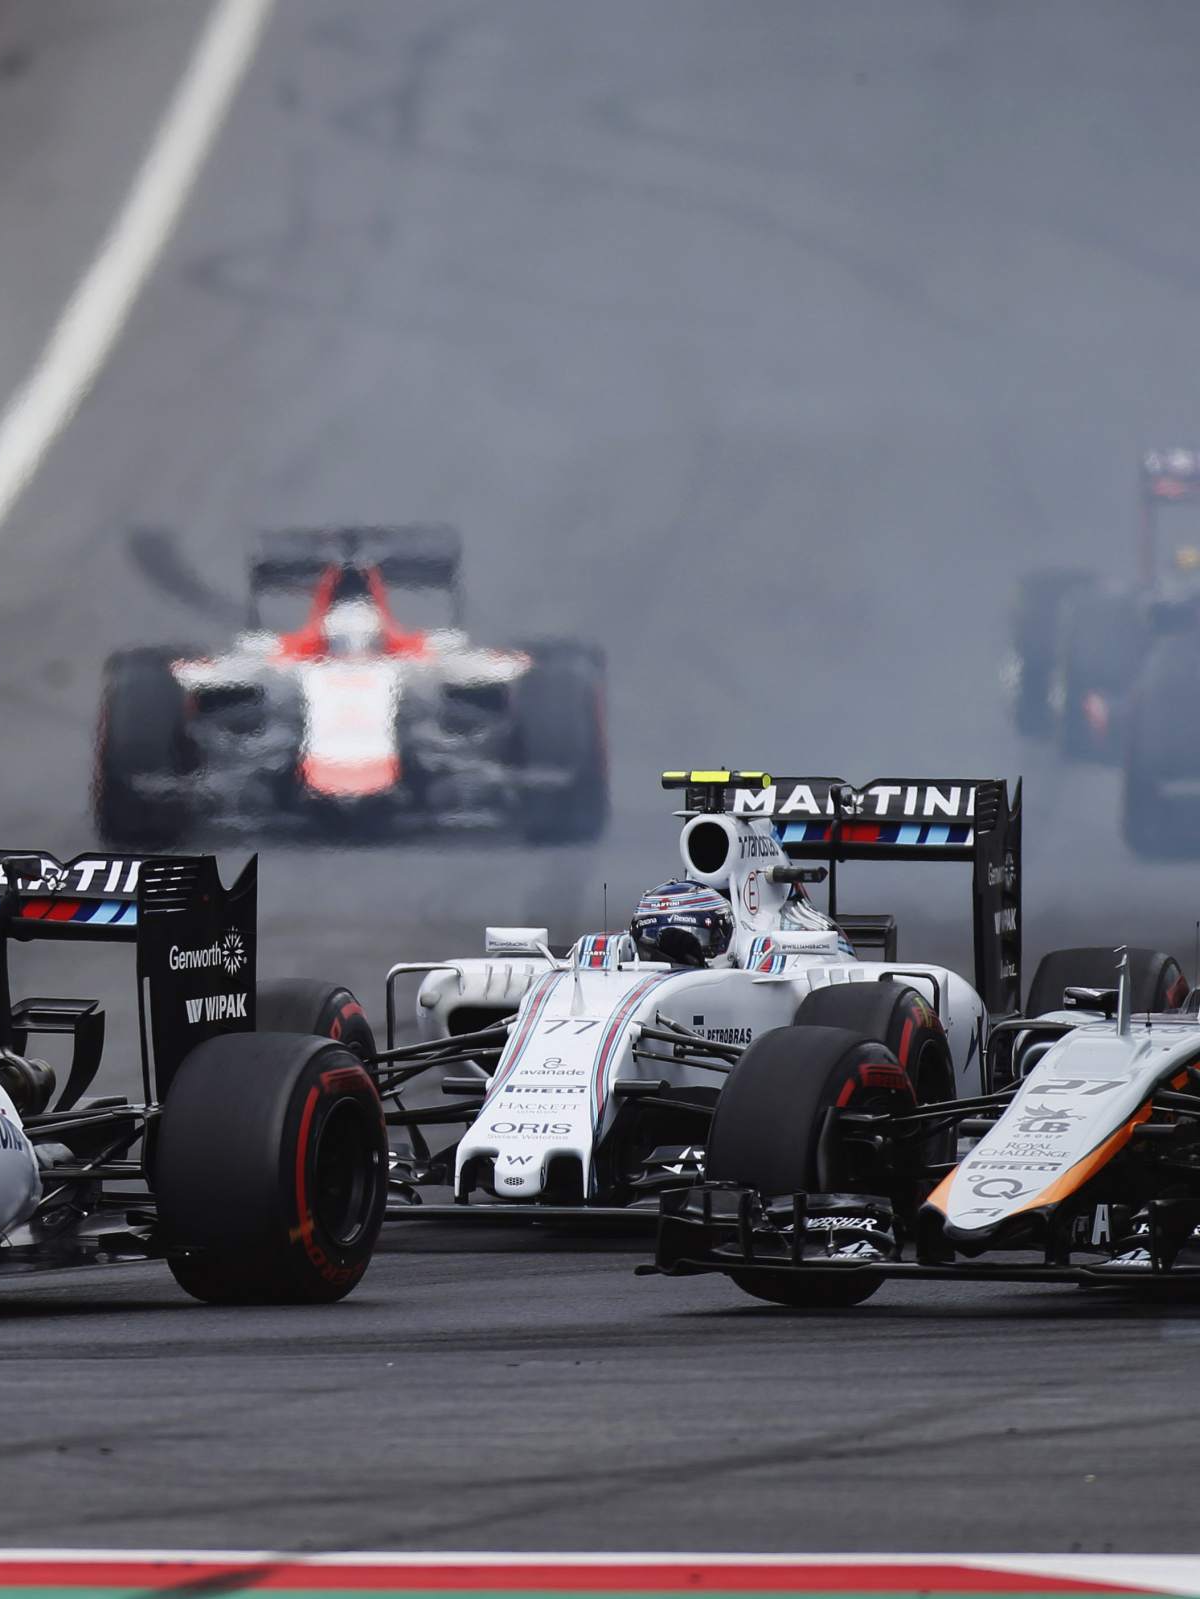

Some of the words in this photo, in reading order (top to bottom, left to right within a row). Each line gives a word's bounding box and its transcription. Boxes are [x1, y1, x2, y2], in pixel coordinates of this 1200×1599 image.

[169, 941, 222, 971] Genworth
[204, 993, 248, 1022] WIPAK
[543, 1019, 600, 1035] 77
[707, 1028, 752, 1044] PETROBRAS
[519, 1068, 585, 1076] avanade
[505, 1085, 588, 1093] PIRELLI
[1027, 1079, 1129, 1096] 27
[498, 1102, 581, 1110] HACKETT
[490, 1122, 573, 1134] ORIS
[1005, 1142, 1053, 1150] ROYAL
[978, 1149, 1072, 1159] CHALLENGE
[967, 1160, 1063, 1172] PIRELLI
